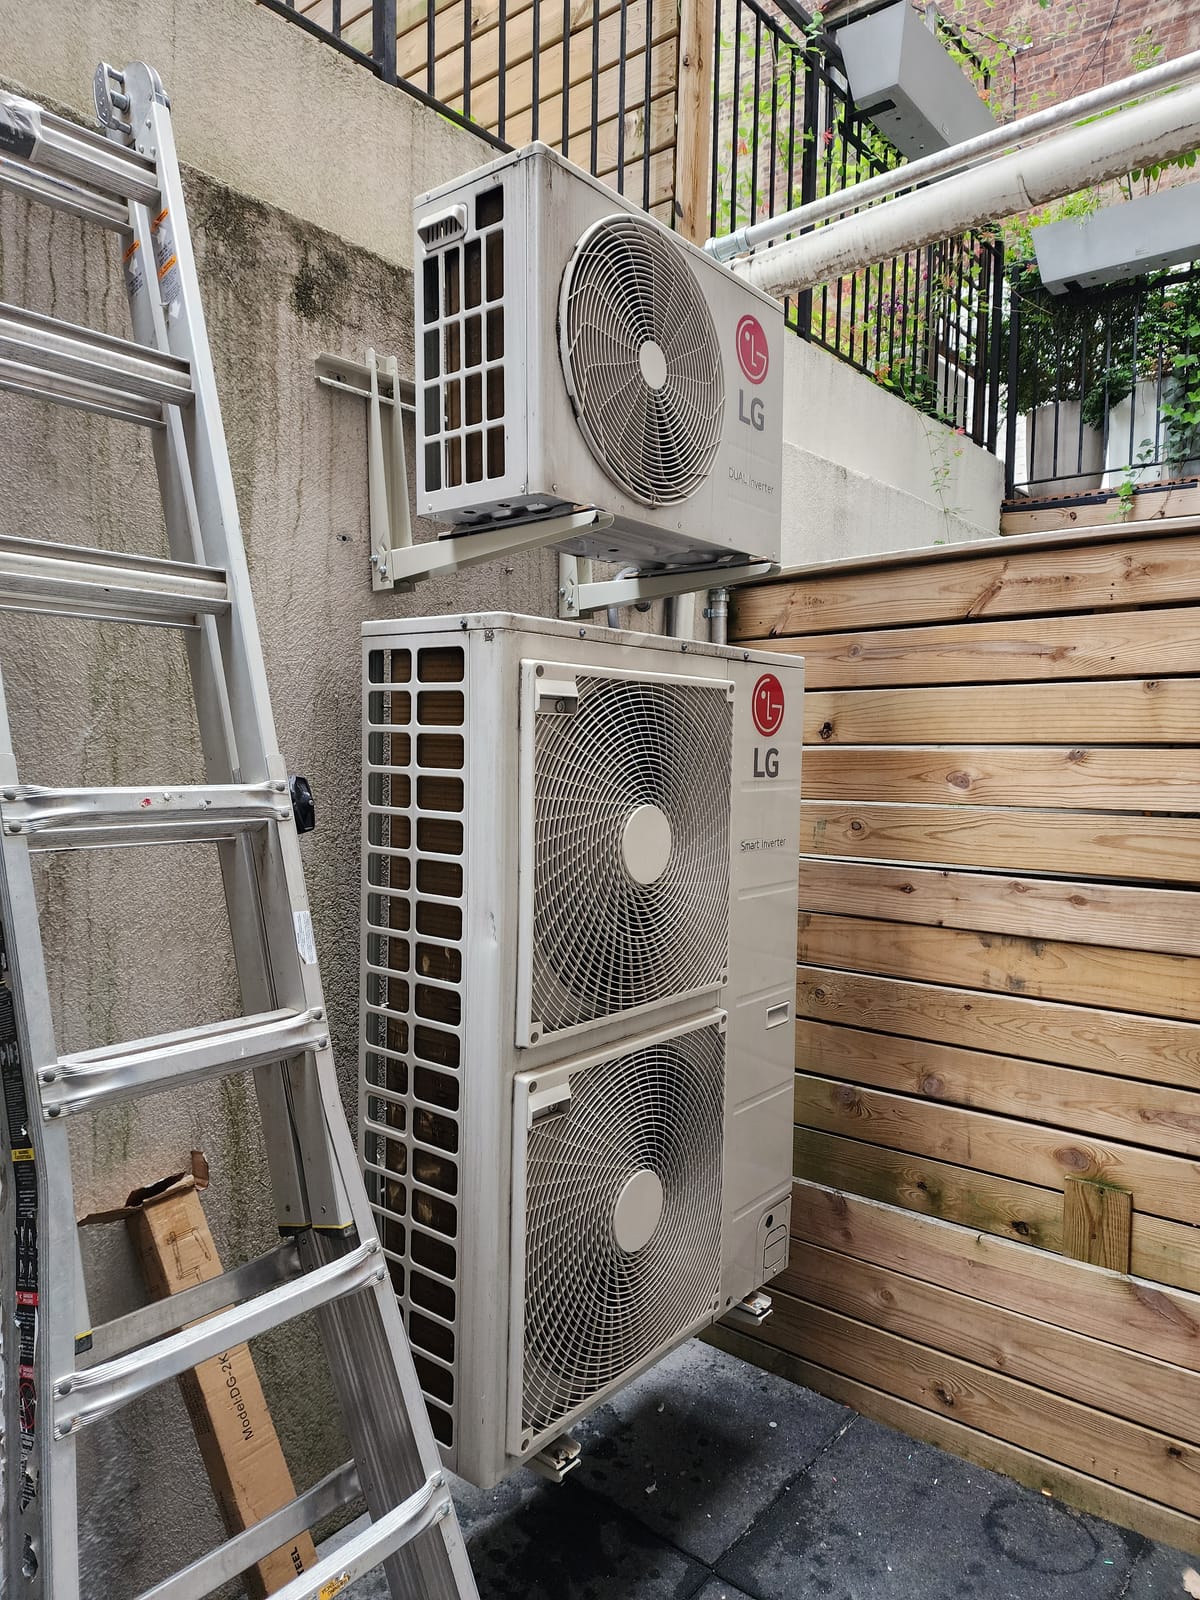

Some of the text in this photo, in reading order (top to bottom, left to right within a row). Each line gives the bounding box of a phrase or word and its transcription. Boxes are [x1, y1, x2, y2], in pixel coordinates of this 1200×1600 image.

[739, 389, 765, 431] LG
[729, 467, 774, 494] DUAL Inverter
[753, 747, 779, 778] LG
[741, 839, 786, 851] Smart Inverter
[218, 1353, 254, 1441] Model:DG-2K
